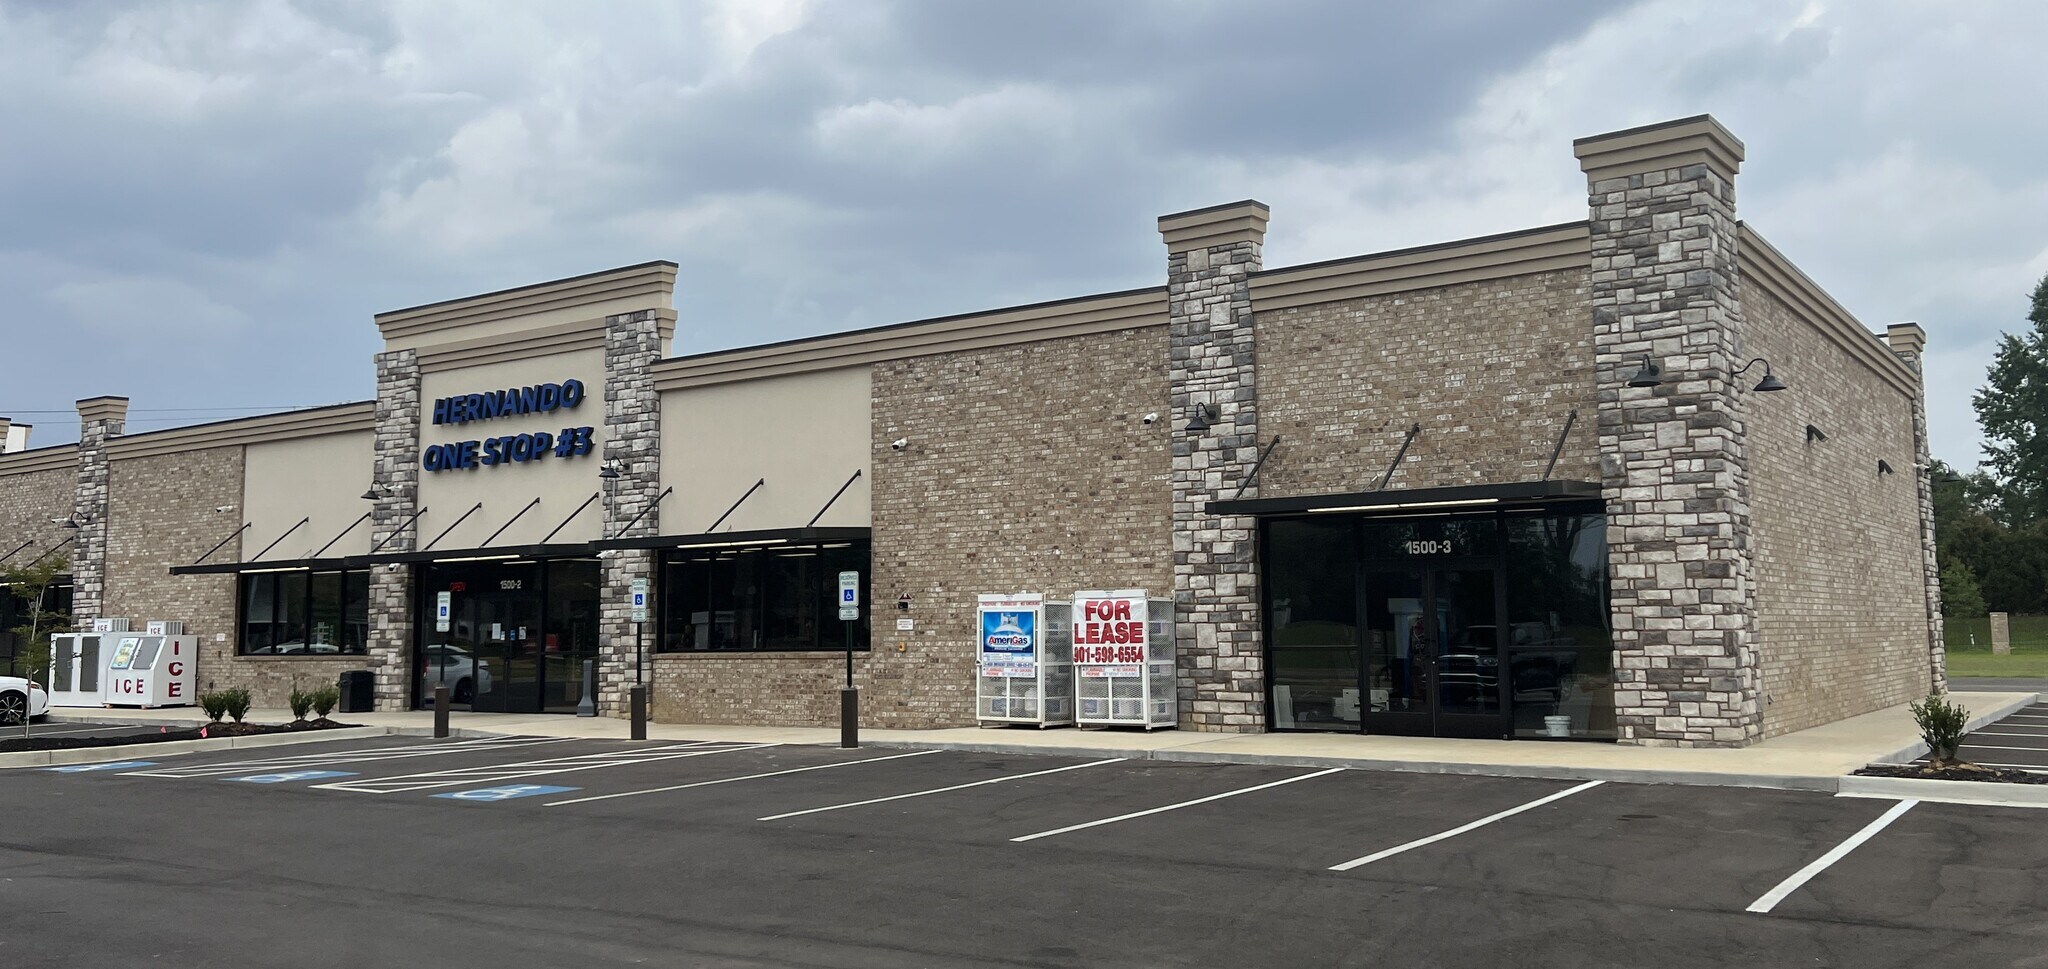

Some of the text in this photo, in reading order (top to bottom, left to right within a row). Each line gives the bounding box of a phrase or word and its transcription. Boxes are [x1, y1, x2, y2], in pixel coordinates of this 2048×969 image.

[432, 378, 586, 425] HERNANDO
[423, 426, 595, 472] ONE STOP #3
[1405, 539, 1452, 555] 1500-3
[500, 579, 522, 590] 1500-2
[1085, 600, 1131, 621] FOR
[150, 627, 161, 635] ICE
[1074, 622, 1143, 644] LEASE
[988, 635, 1028, 645] AmeriGas
[1073, 646, 1144, 663] 901-598-6554
[168, 640, 184, 698] ICE
[115, 678, 145, 694] ICE
